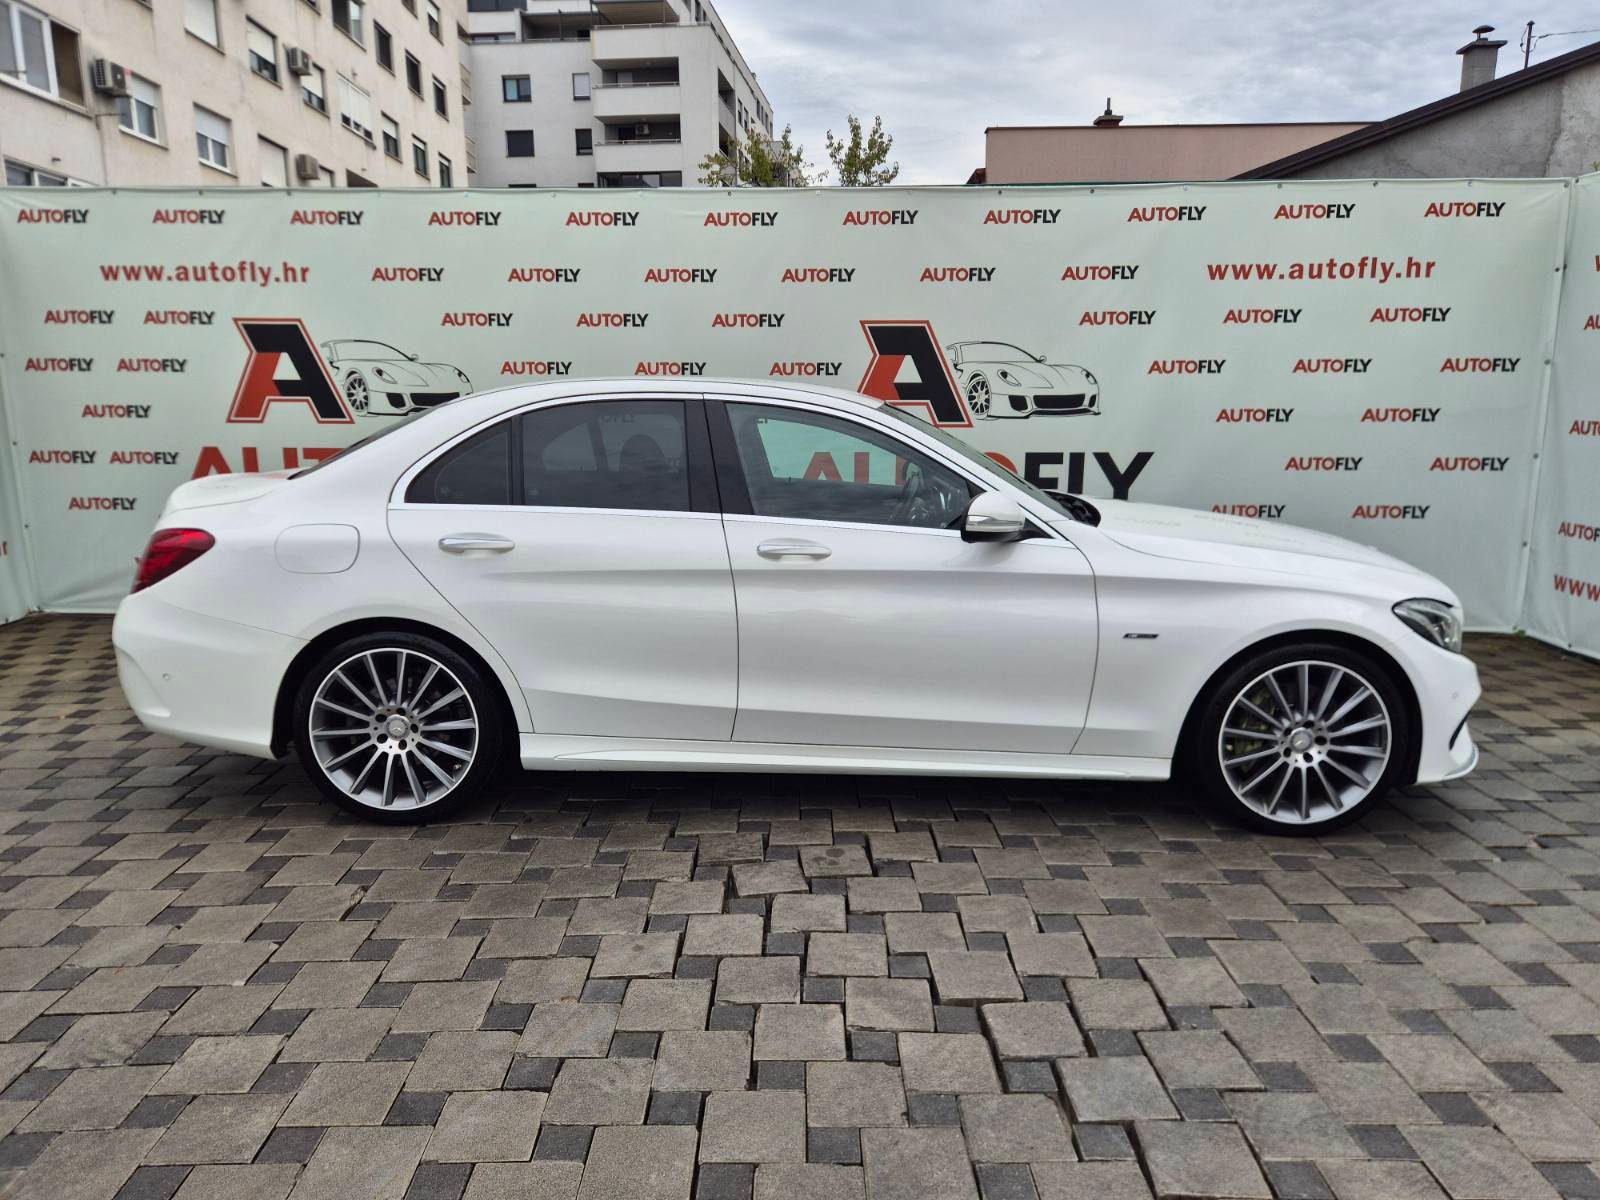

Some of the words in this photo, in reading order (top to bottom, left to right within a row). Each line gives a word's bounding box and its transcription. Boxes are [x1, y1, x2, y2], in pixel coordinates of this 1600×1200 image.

[16, 208, 90, 224] AUTOFLY
[152, 209, 226, 225] AUTOFLY
[842, 209, 919, 226] AUTOFLY
[982, 208, 1062, 225] AUTOFLY
[1127, 205, 1208, 223] AUTOFLY
[1273, 203, 1357, 220] AUTOFLY
[1423, 201, 1507, 218] AUTOFLY
[289, 210, 364, 226] AUTOFLY
[427, 211, 502, 227] AUTOFLY
[565, 211, 640, 227] AUTOFLY
[703, 211, 779, 227] AUTOFLY
[99, 260, 310, 288] www.autofly.hr
[371, 266, 445, 282] AUTOFLY
[507, 267, 582, 283] AUTOFLY
[643, 268, 718, 284] AUTOFLY
[780, 267, 856, 283] AUTOFLY
[919, 267, 997, 283] AUTOFLY
[1060, 264, 1140, 281] AUTOFLY
[1206, 255, 1437, 284] www.autofly.hr
[43, 309, 116, 325] AUTOFLY
[143, 310, 216, 326] AUTOFLY
[440, 312, 514, 328] AUTOFLY
[575, 312, 649, 328] AUTOFLY
[711, 312, 786, 328] AUTOFLY
[1078, 310, 1157, 326] AUTOFLY
[1222, 308, 1303, 324] AUTOFLY
[1369, 306, 1452, 323] AUTOFLY
[23, 356, 95, 373] AUTOFLY
[116, 357, 188, 373] AUTOFLY
[226, 317, 356, 424] A
[500, 360, 573, 376] AUTOFLY
[634, 361, 708, 377] AUTOFLY
[768, 361, 843, 377] AUTOFLY
[1147, 359, 1227, 375] AUTOFLY
[1292, 357, 1373, 374] AUTOFLY
[1439, 357, 1522, 373] AUTOFLY
[857, 320, 974, 428] A
[80, 403, 152, 419] AUTOFLY
[1215, 407, 1295, 423] AUTOFLY
[1360, 407, 1442, 423] AUTOFLY
[27, 448, 98, 465] AUTOFLY
[108, 450, 181, 466] AUTOFLY
[1283, 456, 1364, 472] AUTOFLY
[1428, 456, 1511, 472] AUTOFLY
[67, 496, 138, 512] AUTOFLY
[1349, 504, 1431, 520] AUTOFLY
